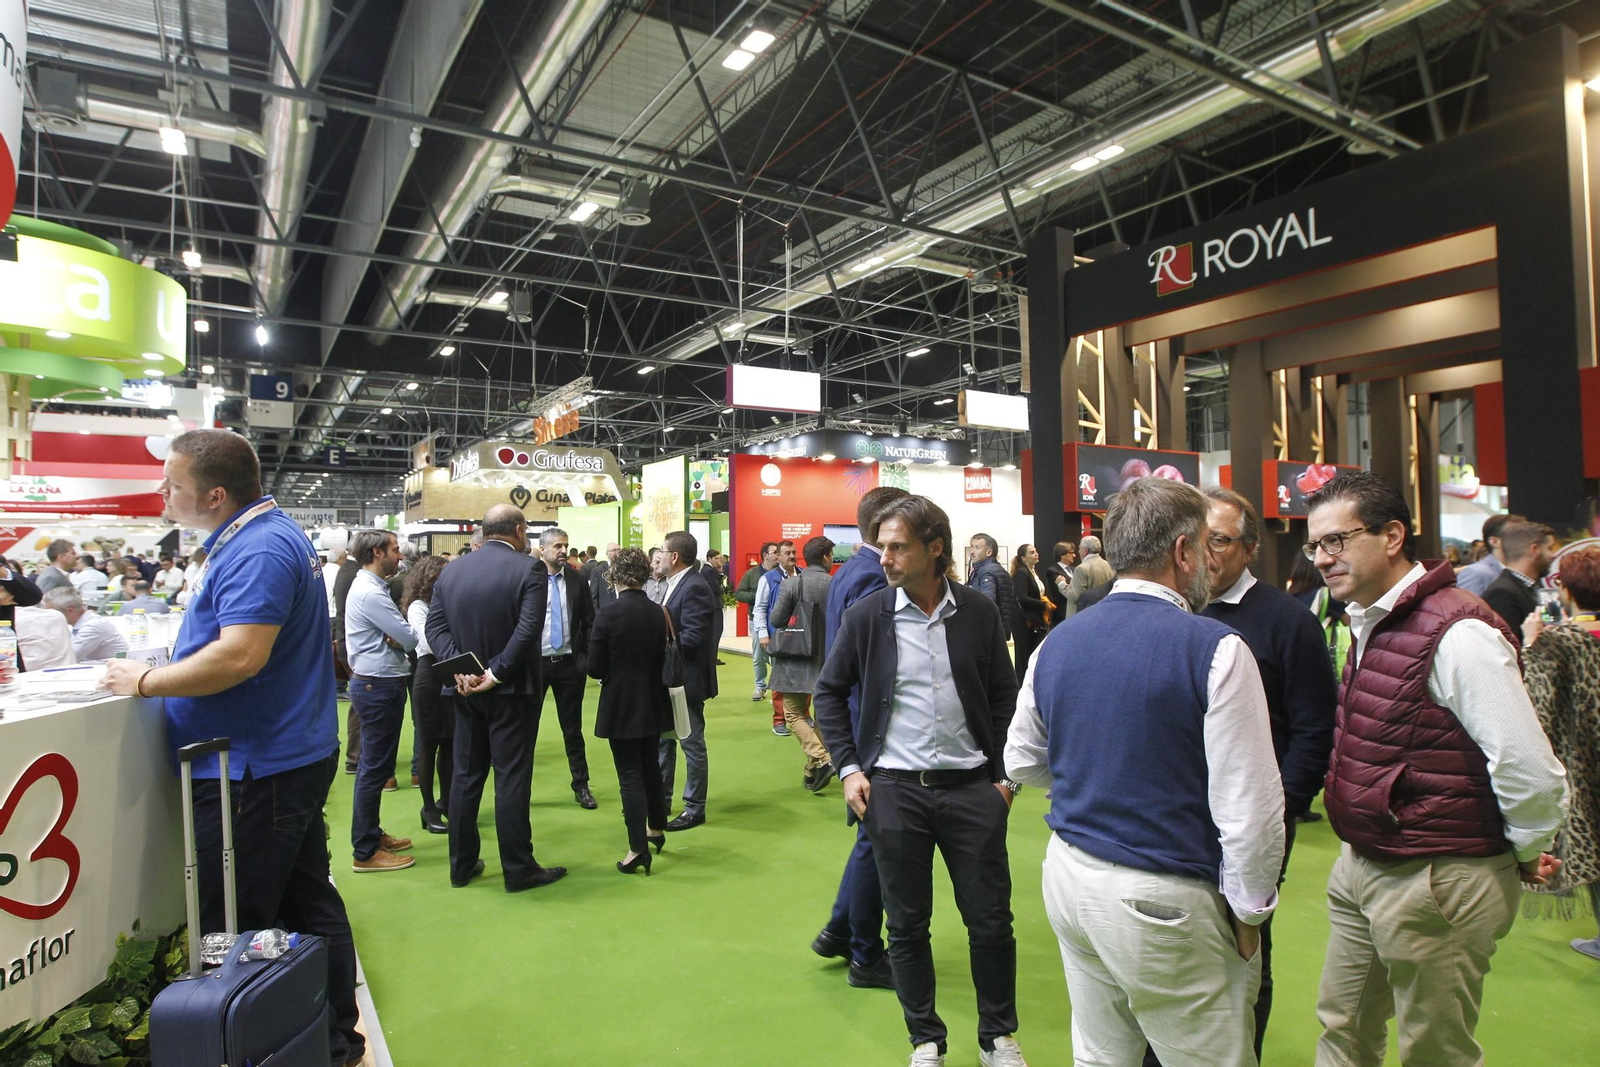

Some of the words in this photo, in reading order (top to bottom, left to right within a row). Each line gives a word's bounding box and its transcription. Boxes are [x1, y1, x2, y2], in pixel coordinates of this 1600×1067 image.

[1148, 245, 1198, 285] R
[1203, 206, 1333, 278] ROYAL
[275, 381, 289, 399] 9
[329, 449, 340, 465] E
[533, 449, 604, 471] Grufesa
[885, 445, 947, 460] NATURGREEN
[10, 485, 24, 493] LA
[29, 484, 62, 494] CAÑA
[536, 490, 570, 504] Cuna
[585, 492, 618, 504] Plate
